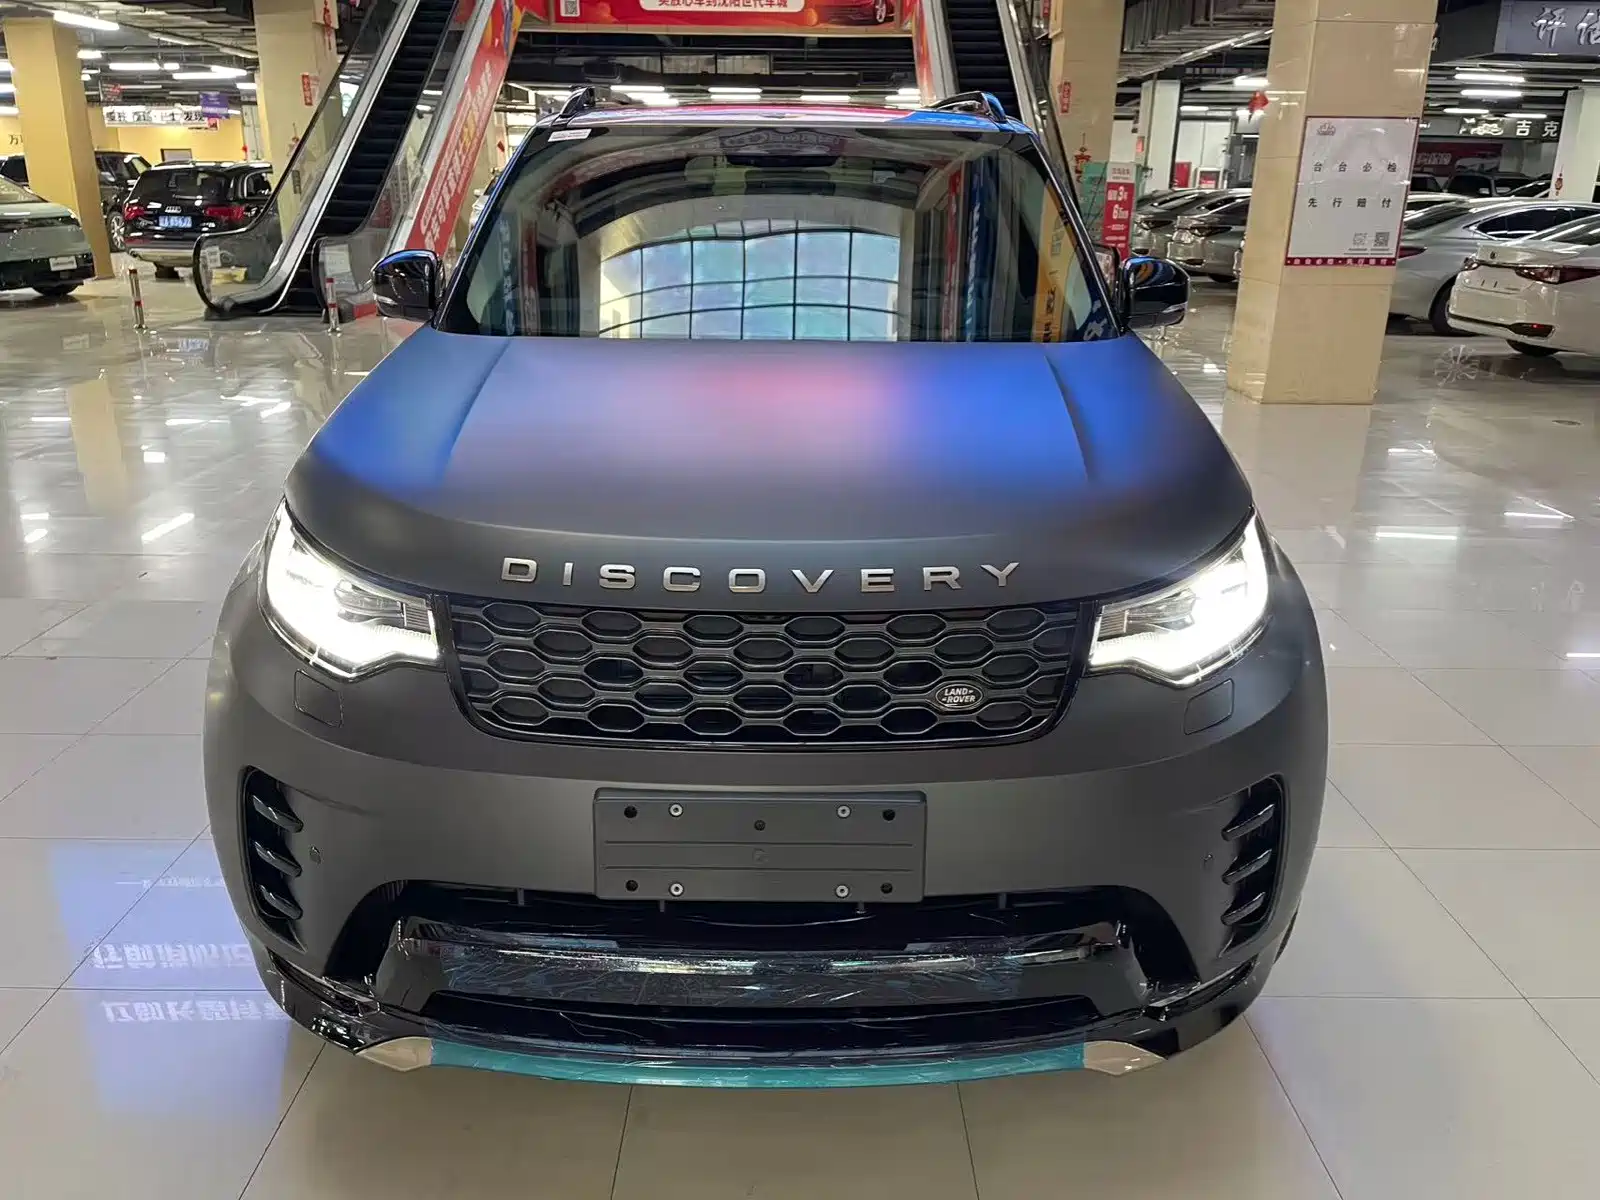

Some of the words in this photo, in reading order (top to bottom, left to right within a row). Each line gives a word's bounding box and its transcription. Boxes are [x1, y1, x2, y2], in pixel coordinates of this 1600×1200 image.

[500, 557, 1020, 593] DISCOVERY
[944, 688, 969, 696] LAND
[946, 695, 976, 703] ROVER
